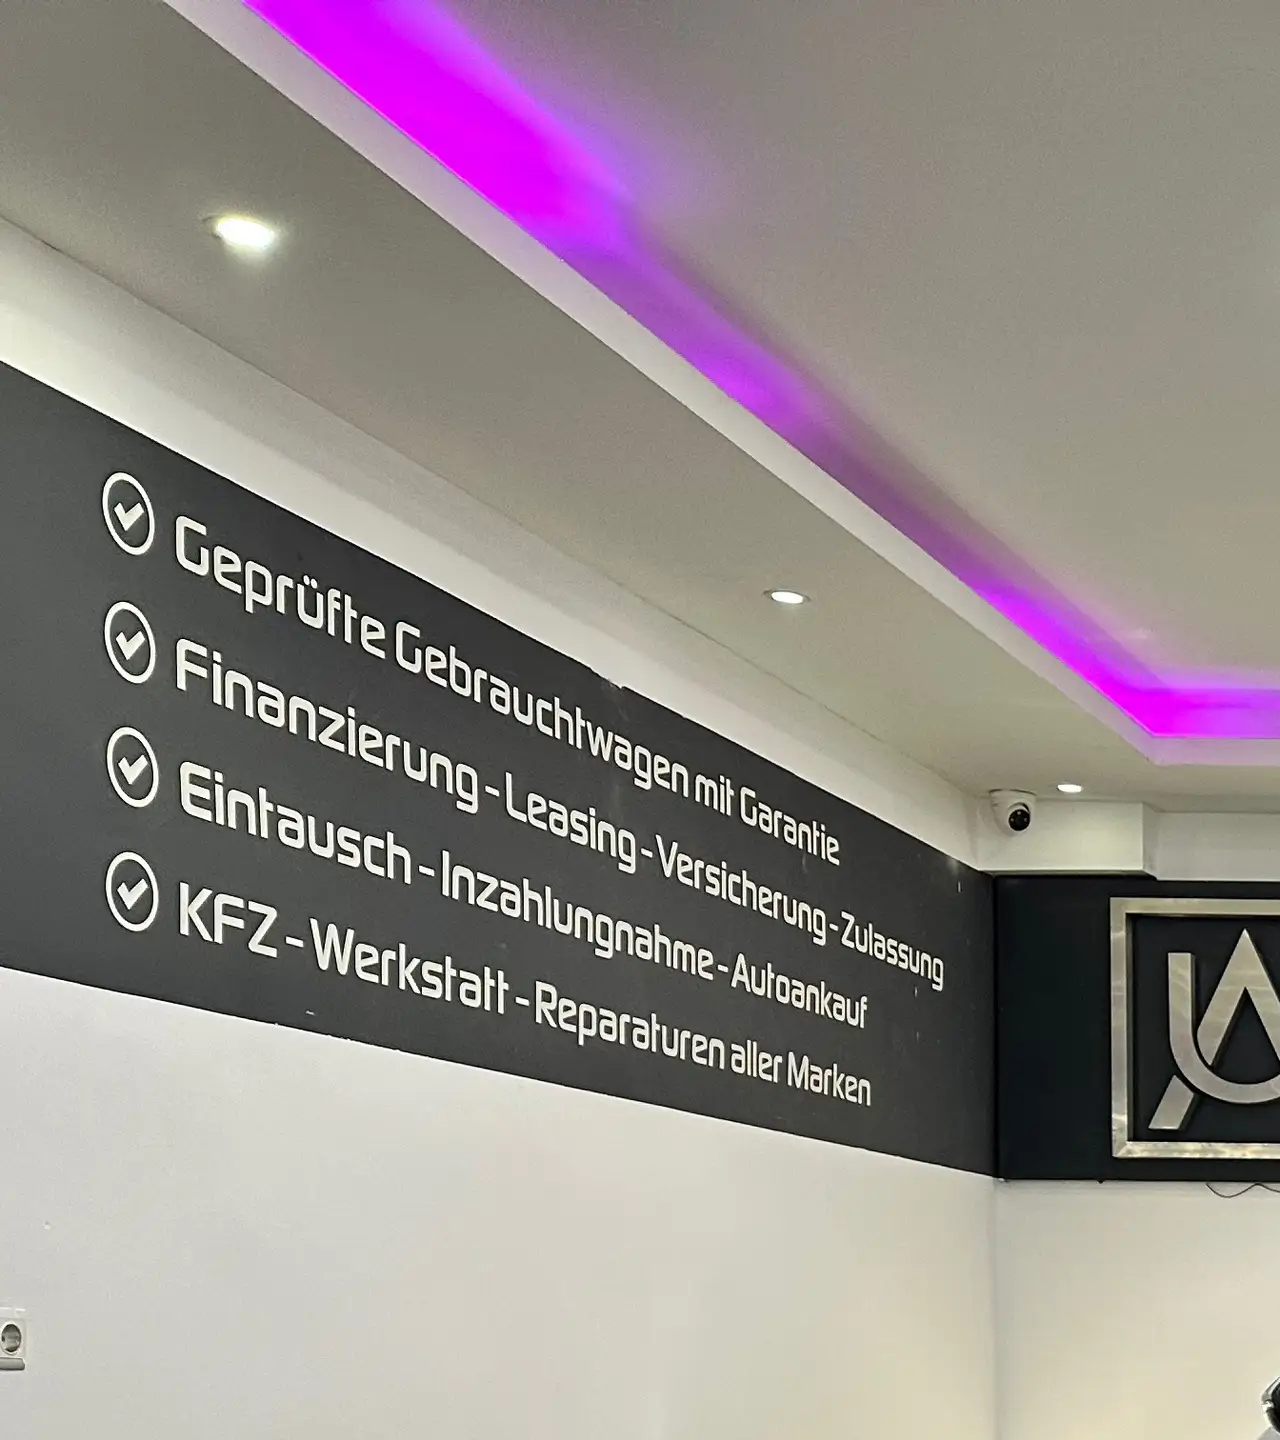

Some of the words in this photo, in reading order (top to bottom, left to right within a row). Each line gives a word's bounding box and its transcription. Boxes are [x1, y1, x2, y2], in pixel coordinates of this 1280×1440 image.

[175, 515, 386, 660] Geprüfte
[395, 621, 689, 799] Gebrauchtwagen
[694, 774, 735, 817] mit
[740, 786, 840, 866] Garantie
[730, 1043, 783, 1084] aller
[787, 1051, 871, 1107] Marken
